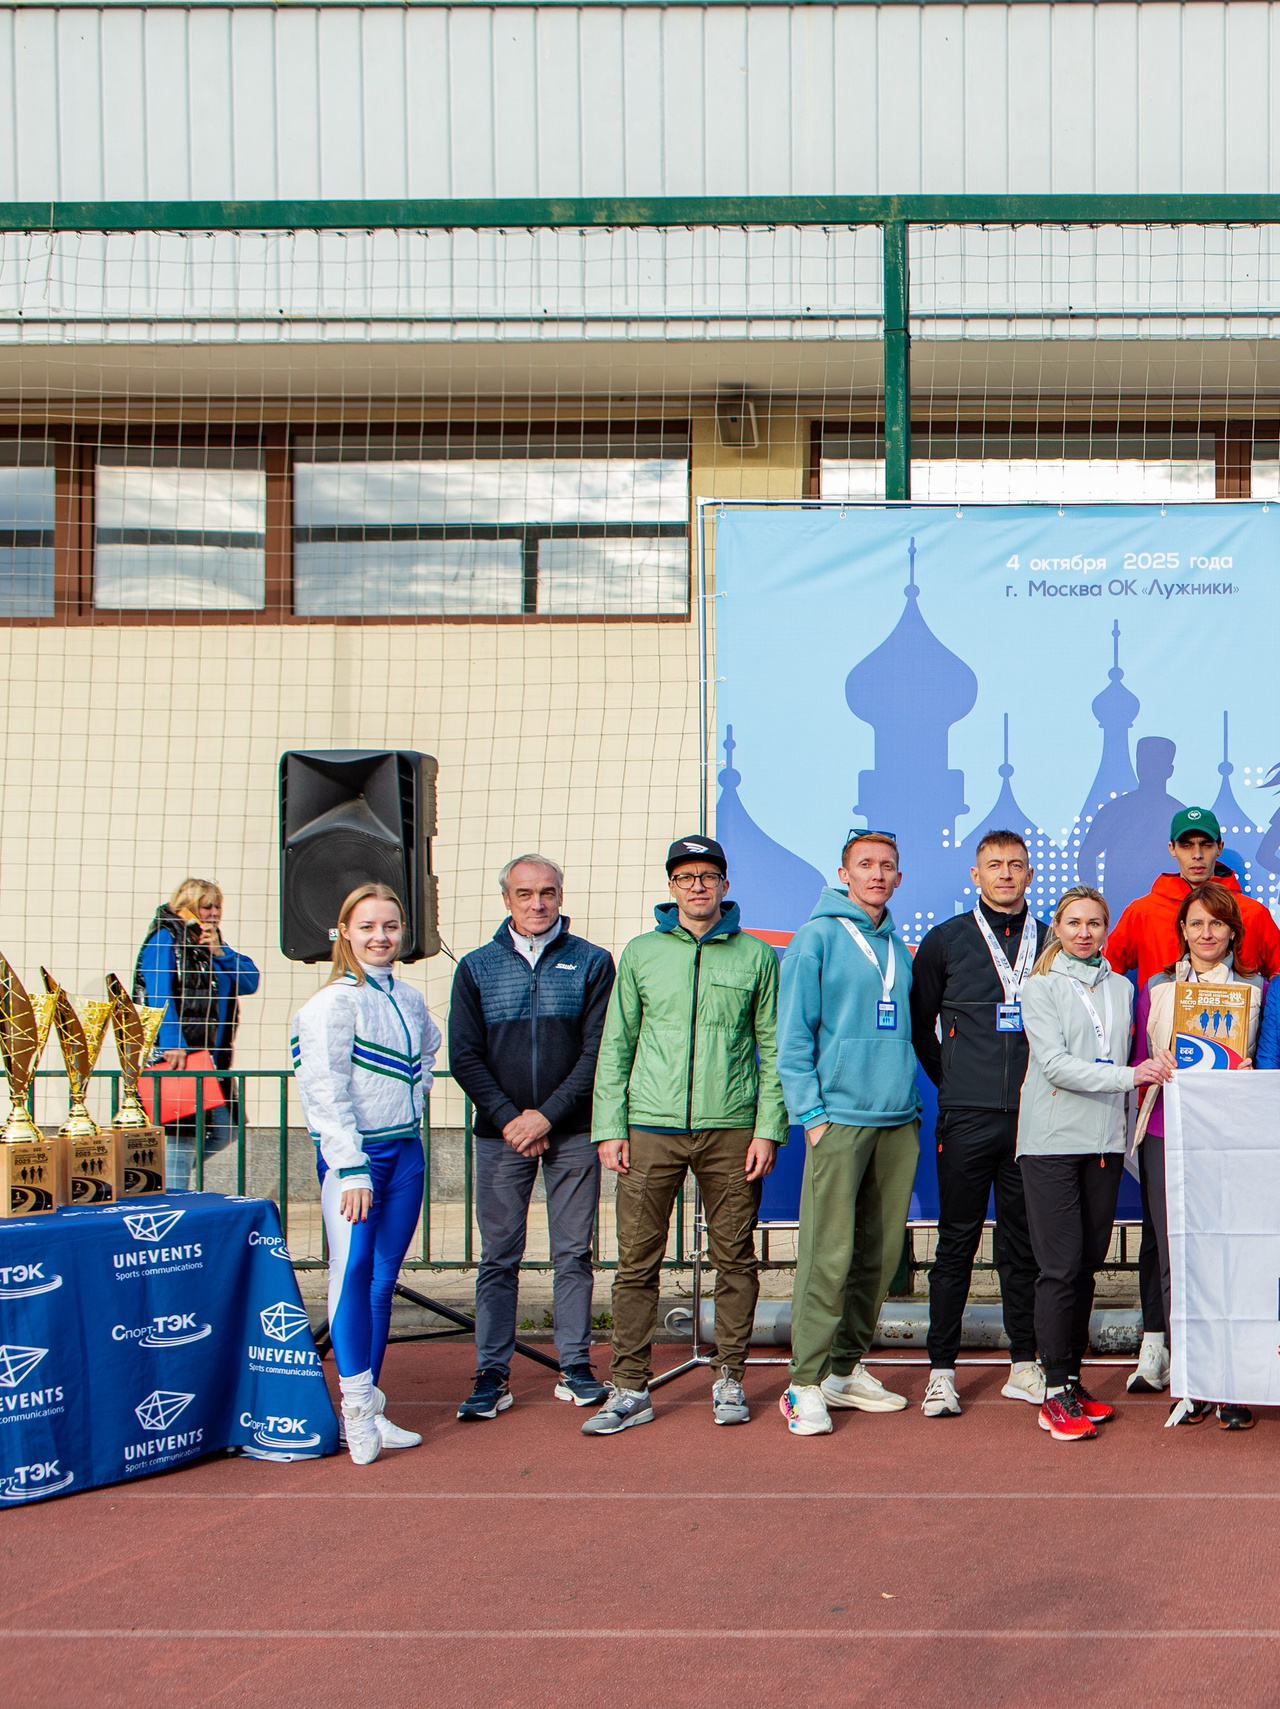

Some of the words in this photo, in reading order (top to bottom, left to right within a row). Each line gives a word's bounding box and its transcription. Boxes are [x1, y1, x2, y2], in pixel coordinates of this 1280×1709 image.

[1006, 554, 1020, 570] 4
[1029, 554, 1107, 574] октября
[1123, 552, 1180, 569] 2025
[1189, 555, 1234, 571] года
[1005, 584, 1018, 597] г.
[1028, 579, 1103, 597] Москва
[1107, 579, 1138, 596] ОК
[1142, 578, 1240, 600] «Лужники»
[1185, 989, 1193, 1000] 2
[1197, 996, 1221, 1005] 2025
[14, 1158, 31, 1166] 2025
[75, 1182, 82, 1191] 2
[113, 1243, 203, 1269] UNEVENTS
[115, 1269, 141, 1281] Sports
[141, 1261, 204, 1277] communications
[248, 1345, 322, 1367] UNEVENTS
[124, 1427, 204, 1461] UNEVENTS
[125, 1461, 148, 1473] Sports
[149, 1445, 201, 1467] communications
